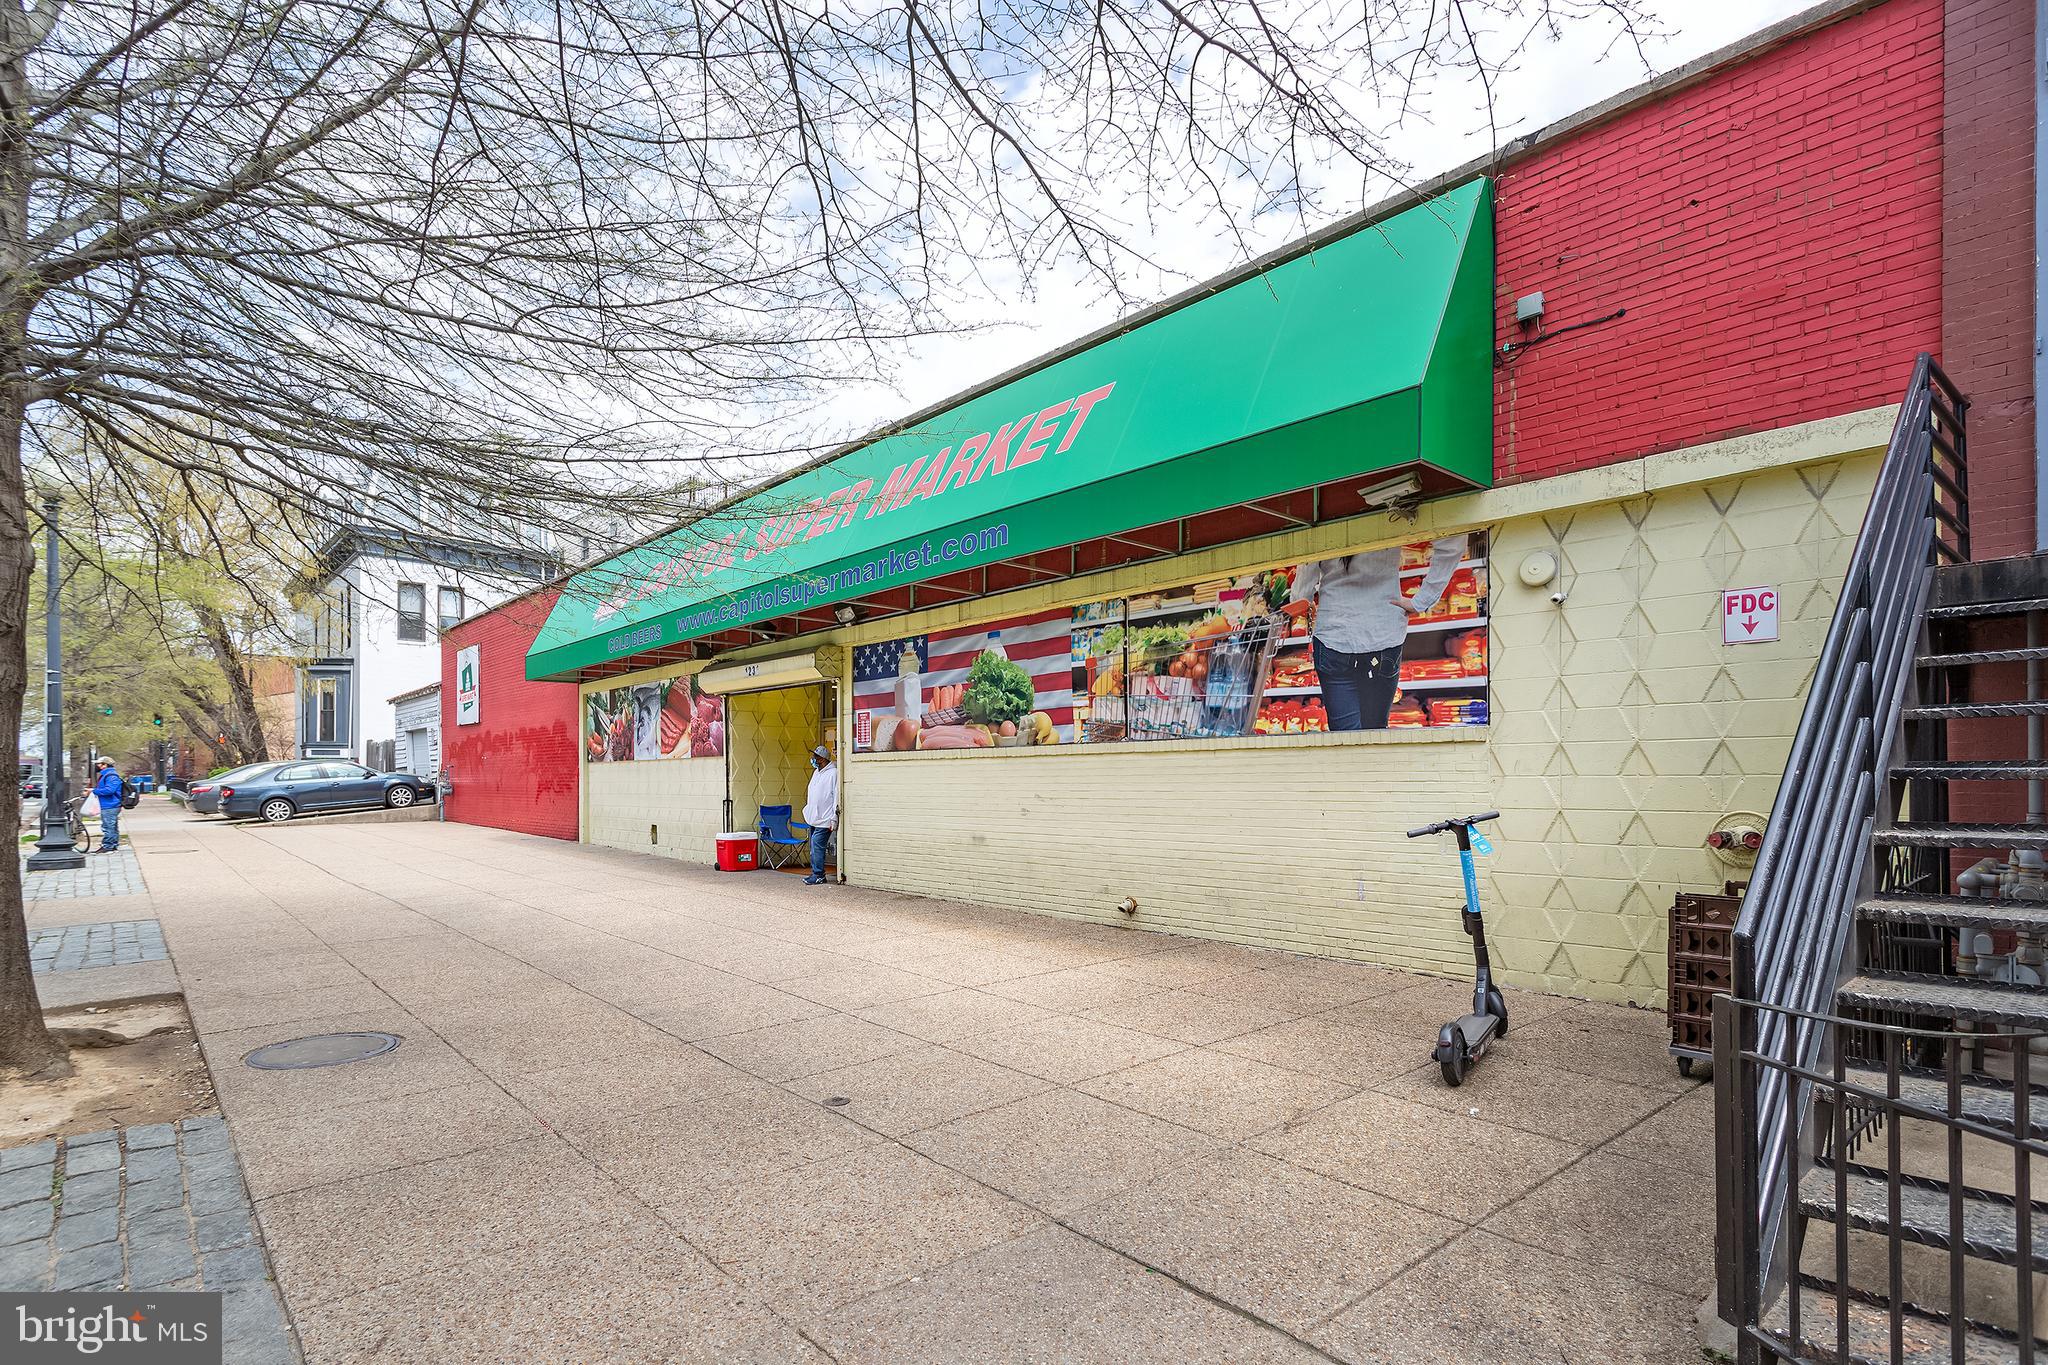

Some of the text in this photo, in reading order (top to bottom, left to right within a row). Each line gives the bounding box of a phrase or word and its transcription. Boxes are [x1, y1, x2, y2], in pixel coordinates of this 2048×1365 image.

[744, 478, 874, 561] SUPER
[864, 381, 1117, 521] MARKET
[676, 523, 1009, 633] www.capitolsupermarket.com
[1727, 591, 1775, 616] FDC
[608, 624, 662, 654] COLD BEERS
